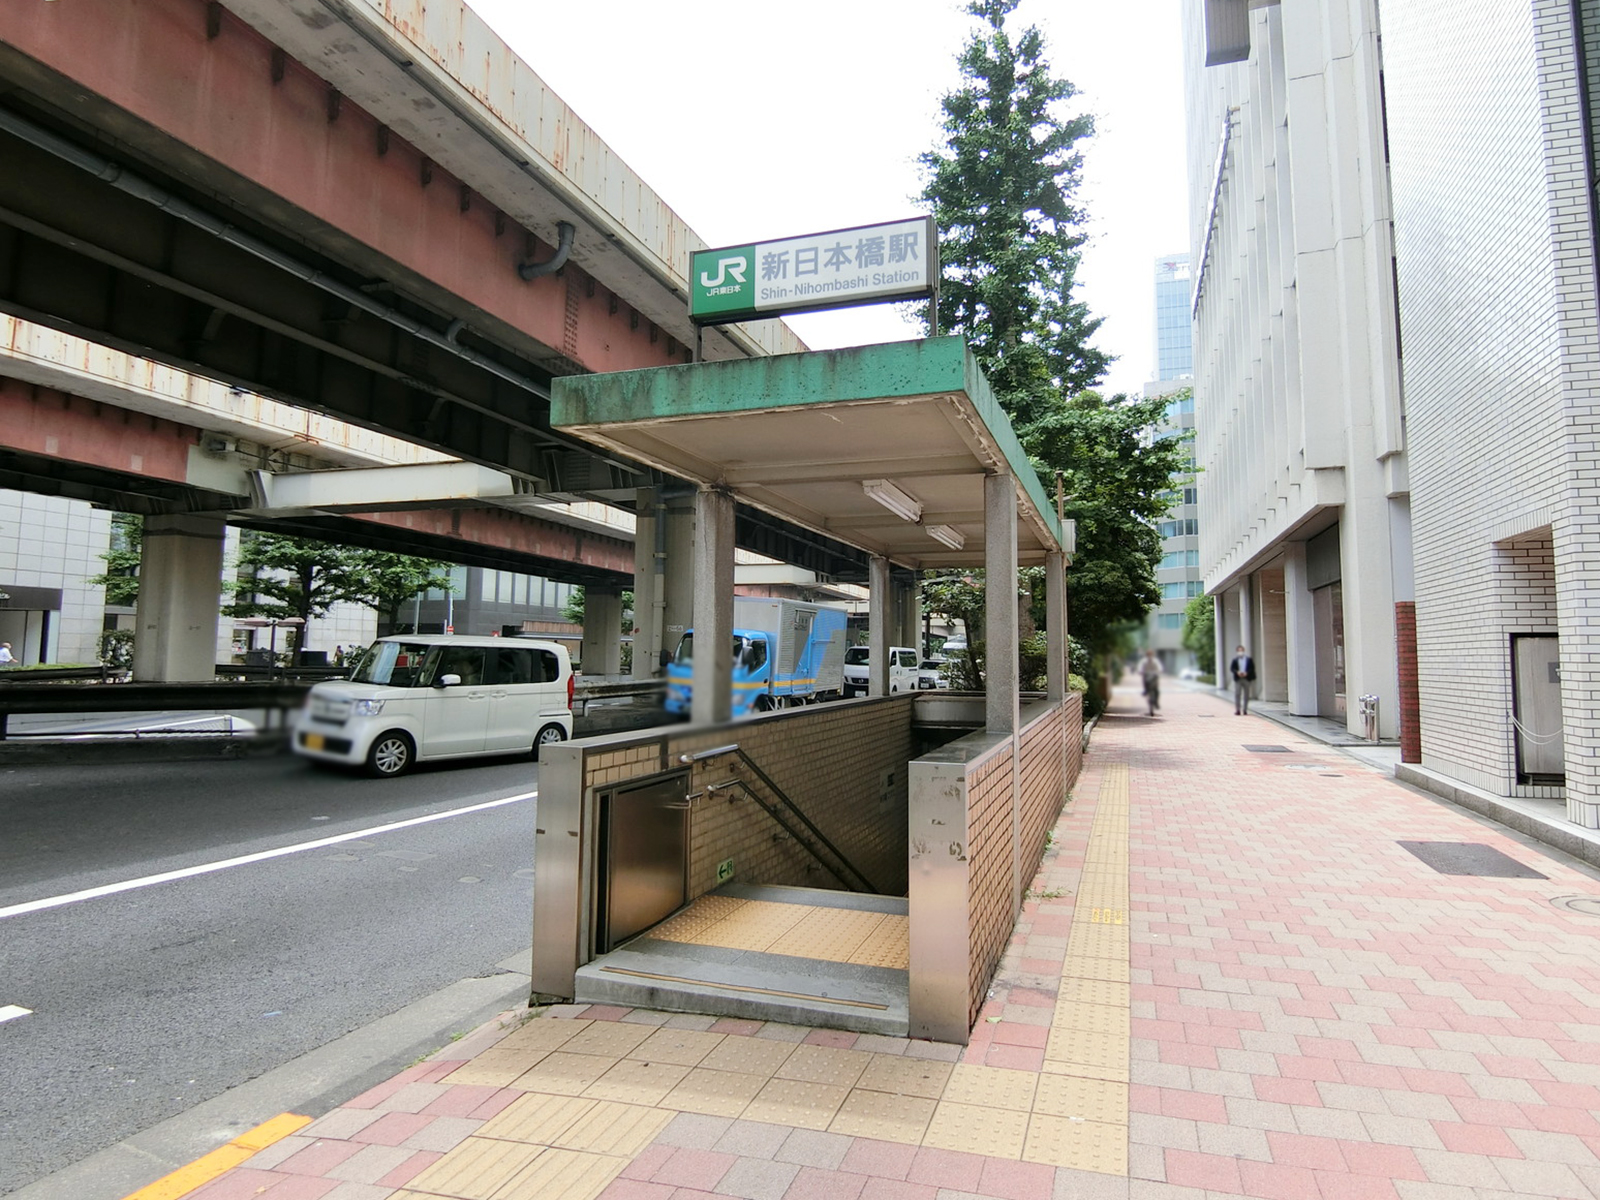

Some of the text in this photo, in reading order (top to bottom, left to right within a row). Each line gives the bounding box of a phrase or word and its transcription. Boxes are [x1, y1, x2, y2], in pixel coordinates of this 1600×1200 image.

[701, 256, 747, 287] JR
[761, 232, 918, 281] 新日本橋駅
[761, 270, 919, 300] Shin-Nihombashi Station
